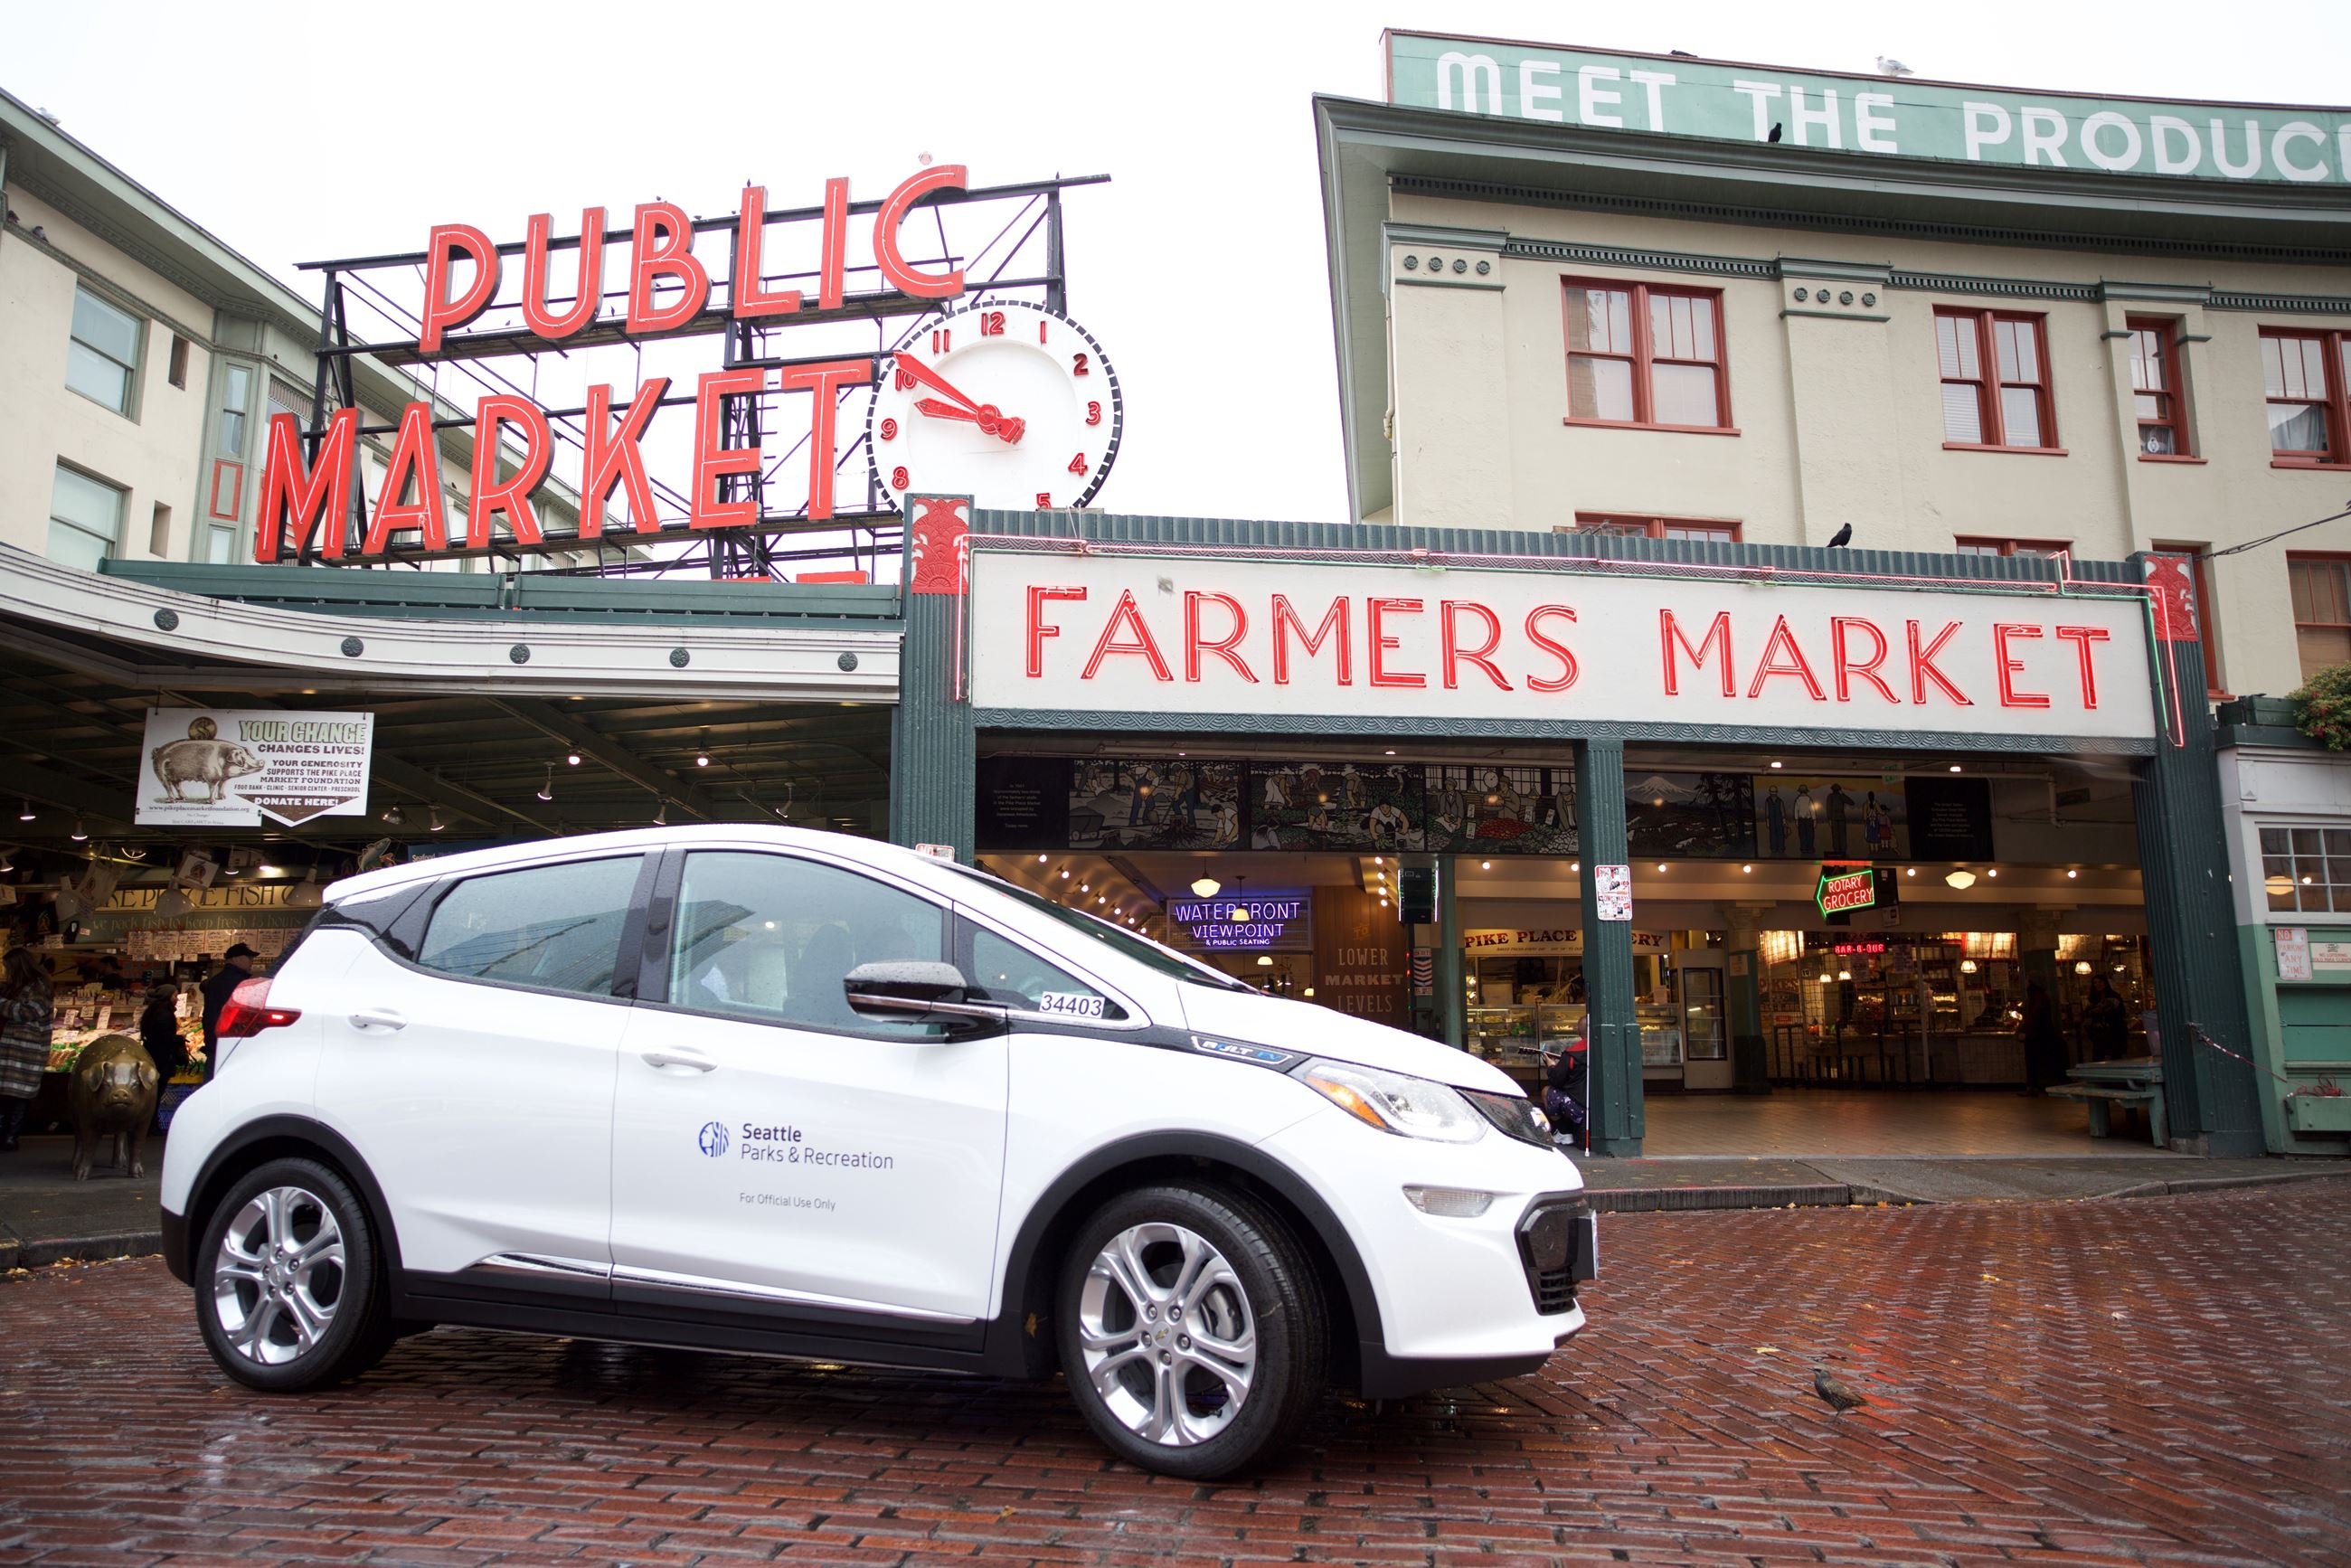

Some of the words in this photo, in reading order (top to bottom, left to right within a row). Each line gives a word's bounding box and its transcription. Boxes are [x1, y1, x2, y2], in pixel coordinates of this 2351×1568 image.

[1437, 51, 1676, 133] MEET
[1733, 80, 1898, 155] THE
[419, 164, 968, 353] PUBLIC
[981, 311, 1005, 335] 12
[933, 328, 949, 354] 11
[1073, 353, 1089, 376] 2
[1086, 401, 1101, 425] 3
[881, 419, 898, 440] 9
[255, 358, 875, 563] MARKET
[1068, 452, 1088, 476] 4
[892, 466, 910, 490] 8
[1026, 584, 1581, 693] FARMERS
[1659, 608, 2110, 710] MARKET
[239, 721, 289, 741] YOUR
[292, 723, 367, 744] CHANGE
[258, 744, 320, 753] CHANGES
[324, 746, 364, 754] LIVES!
[254, 797, 302, 806] DONATE
[304, 798, 339, 807] HERE!
[1828, 875, 1862, 893] ROTARY
[224, 885, 276, 906] FISH
[1824, 887, 1873, 910] GROCERY
[1192, 923, 1284, 938] VIEWPOINT
[1464, 930, 1509, 949] PIKE
[1516, 930, 1578, 943] PLACE
[1338, 949, 1388, 966] LOWER
[1326, 974, 1403, 986] MARKET
[1042, 994, 1102, 1015] 34403
[1337, 995, 1393, 1013] LEVELS
[742, 1123, 802, 1142] Seattle
[741, 1144, 784, 1163] Parks
[788, 1147, 799, 1163] &
[804, 1148, 893, 1169] Recreation
[740, 1193, 754, 1204] For
[757, 1194, 791, 1207] Official
[794, 1196, 811, 1208] Use
[814, 1198, 836, 1212] Only
